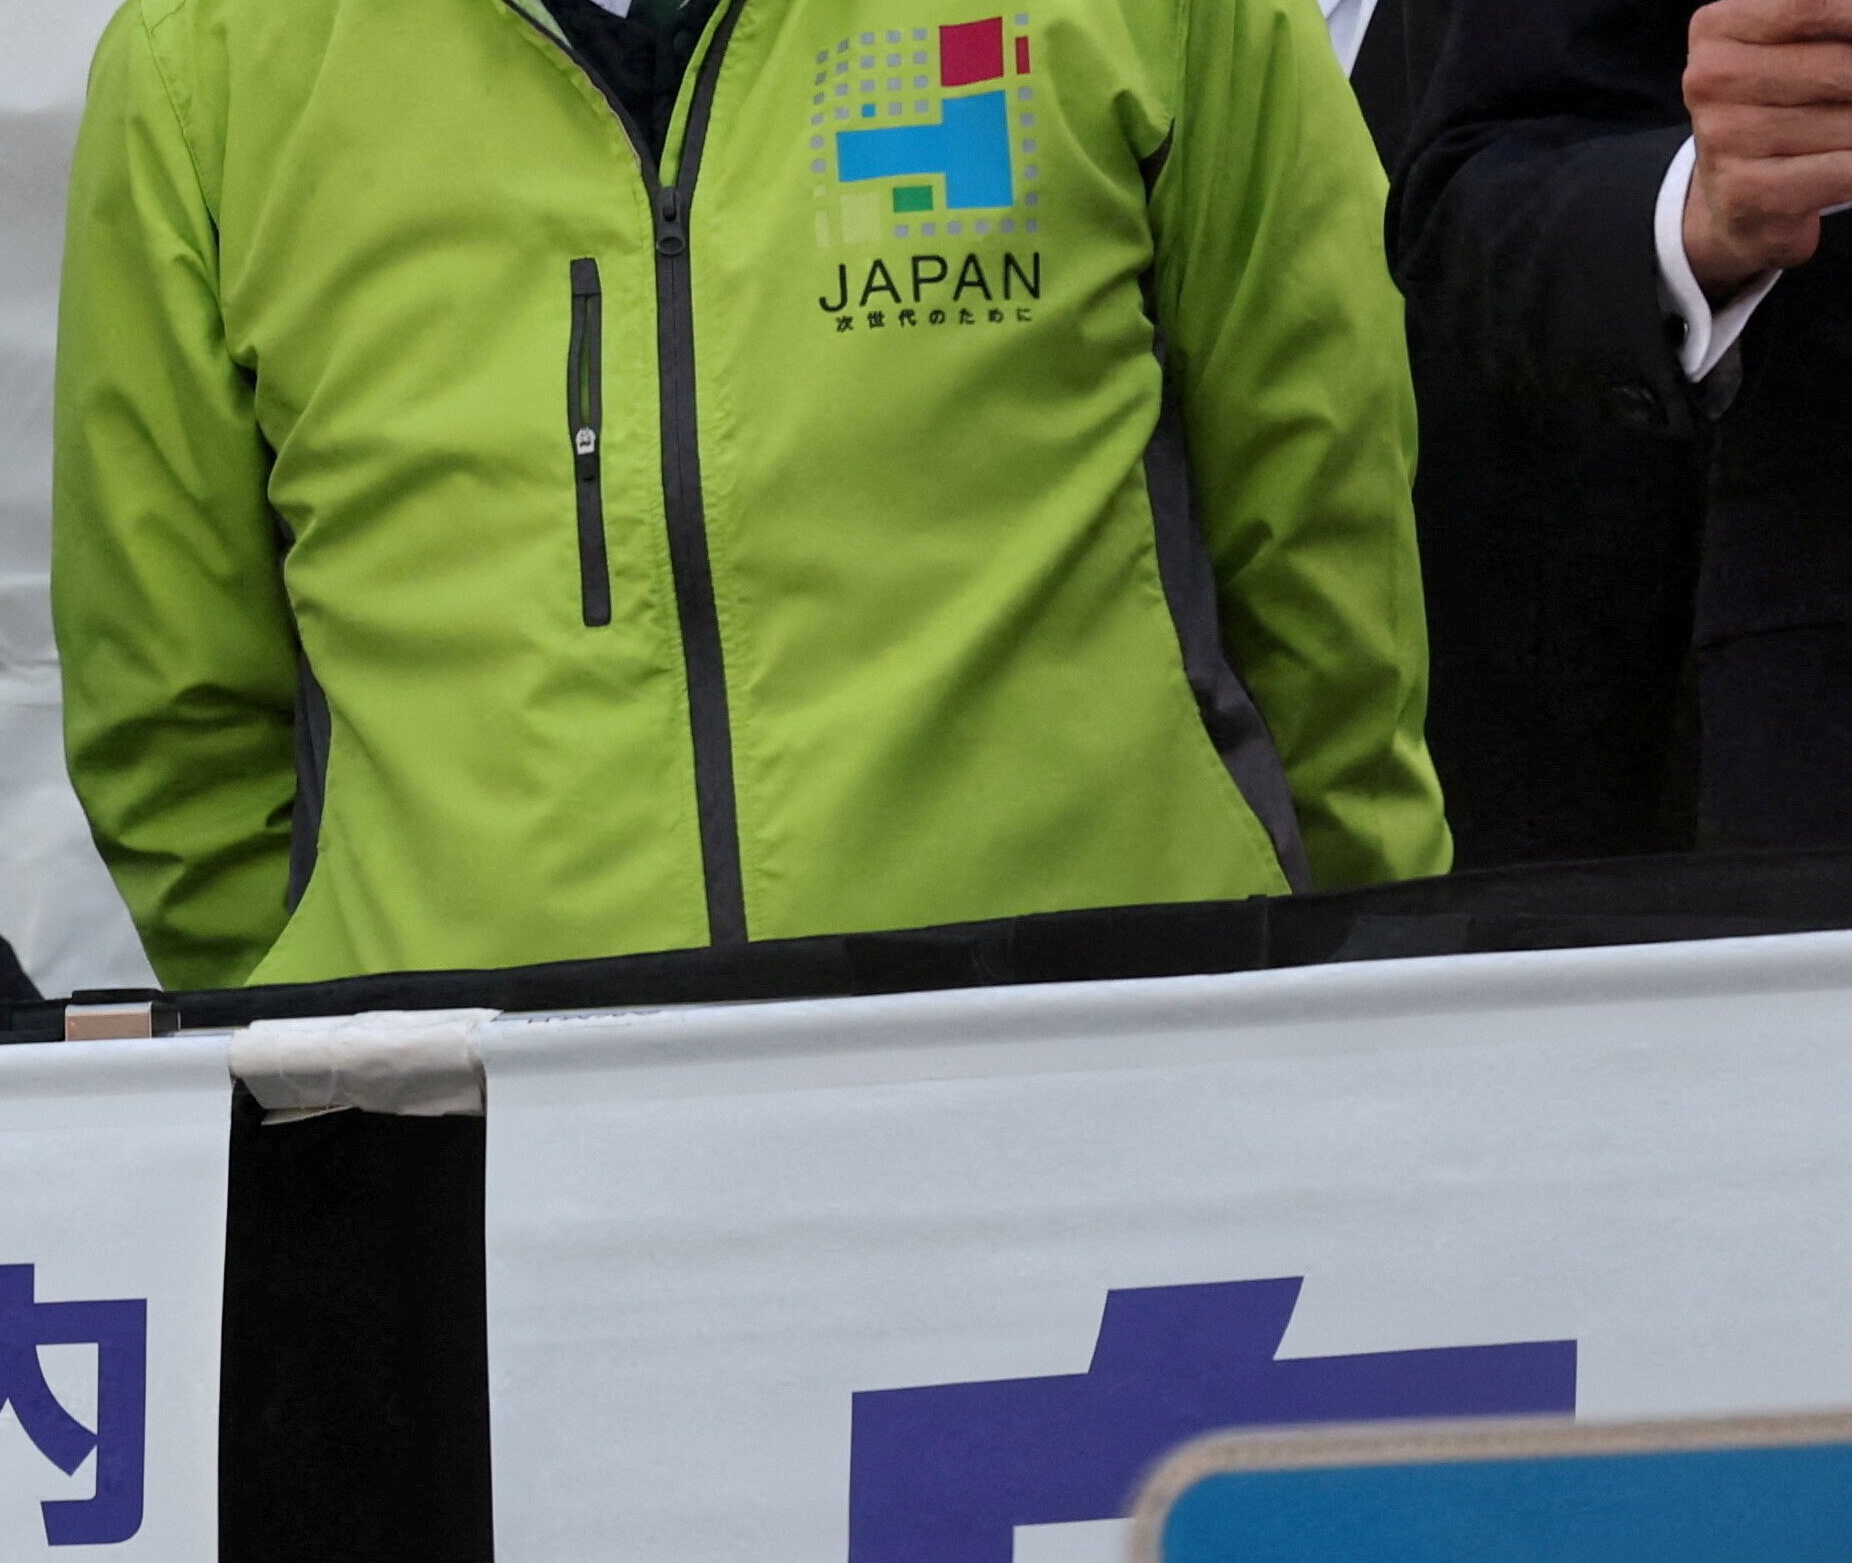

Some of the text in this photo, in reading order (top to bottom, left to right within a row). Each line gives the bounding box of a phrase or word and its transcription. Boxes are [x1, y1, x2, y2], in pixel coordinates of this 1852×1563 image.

[818, 251, 1040, 313] JAPAN
[835, 307, 1033, 333] 次世代のために
